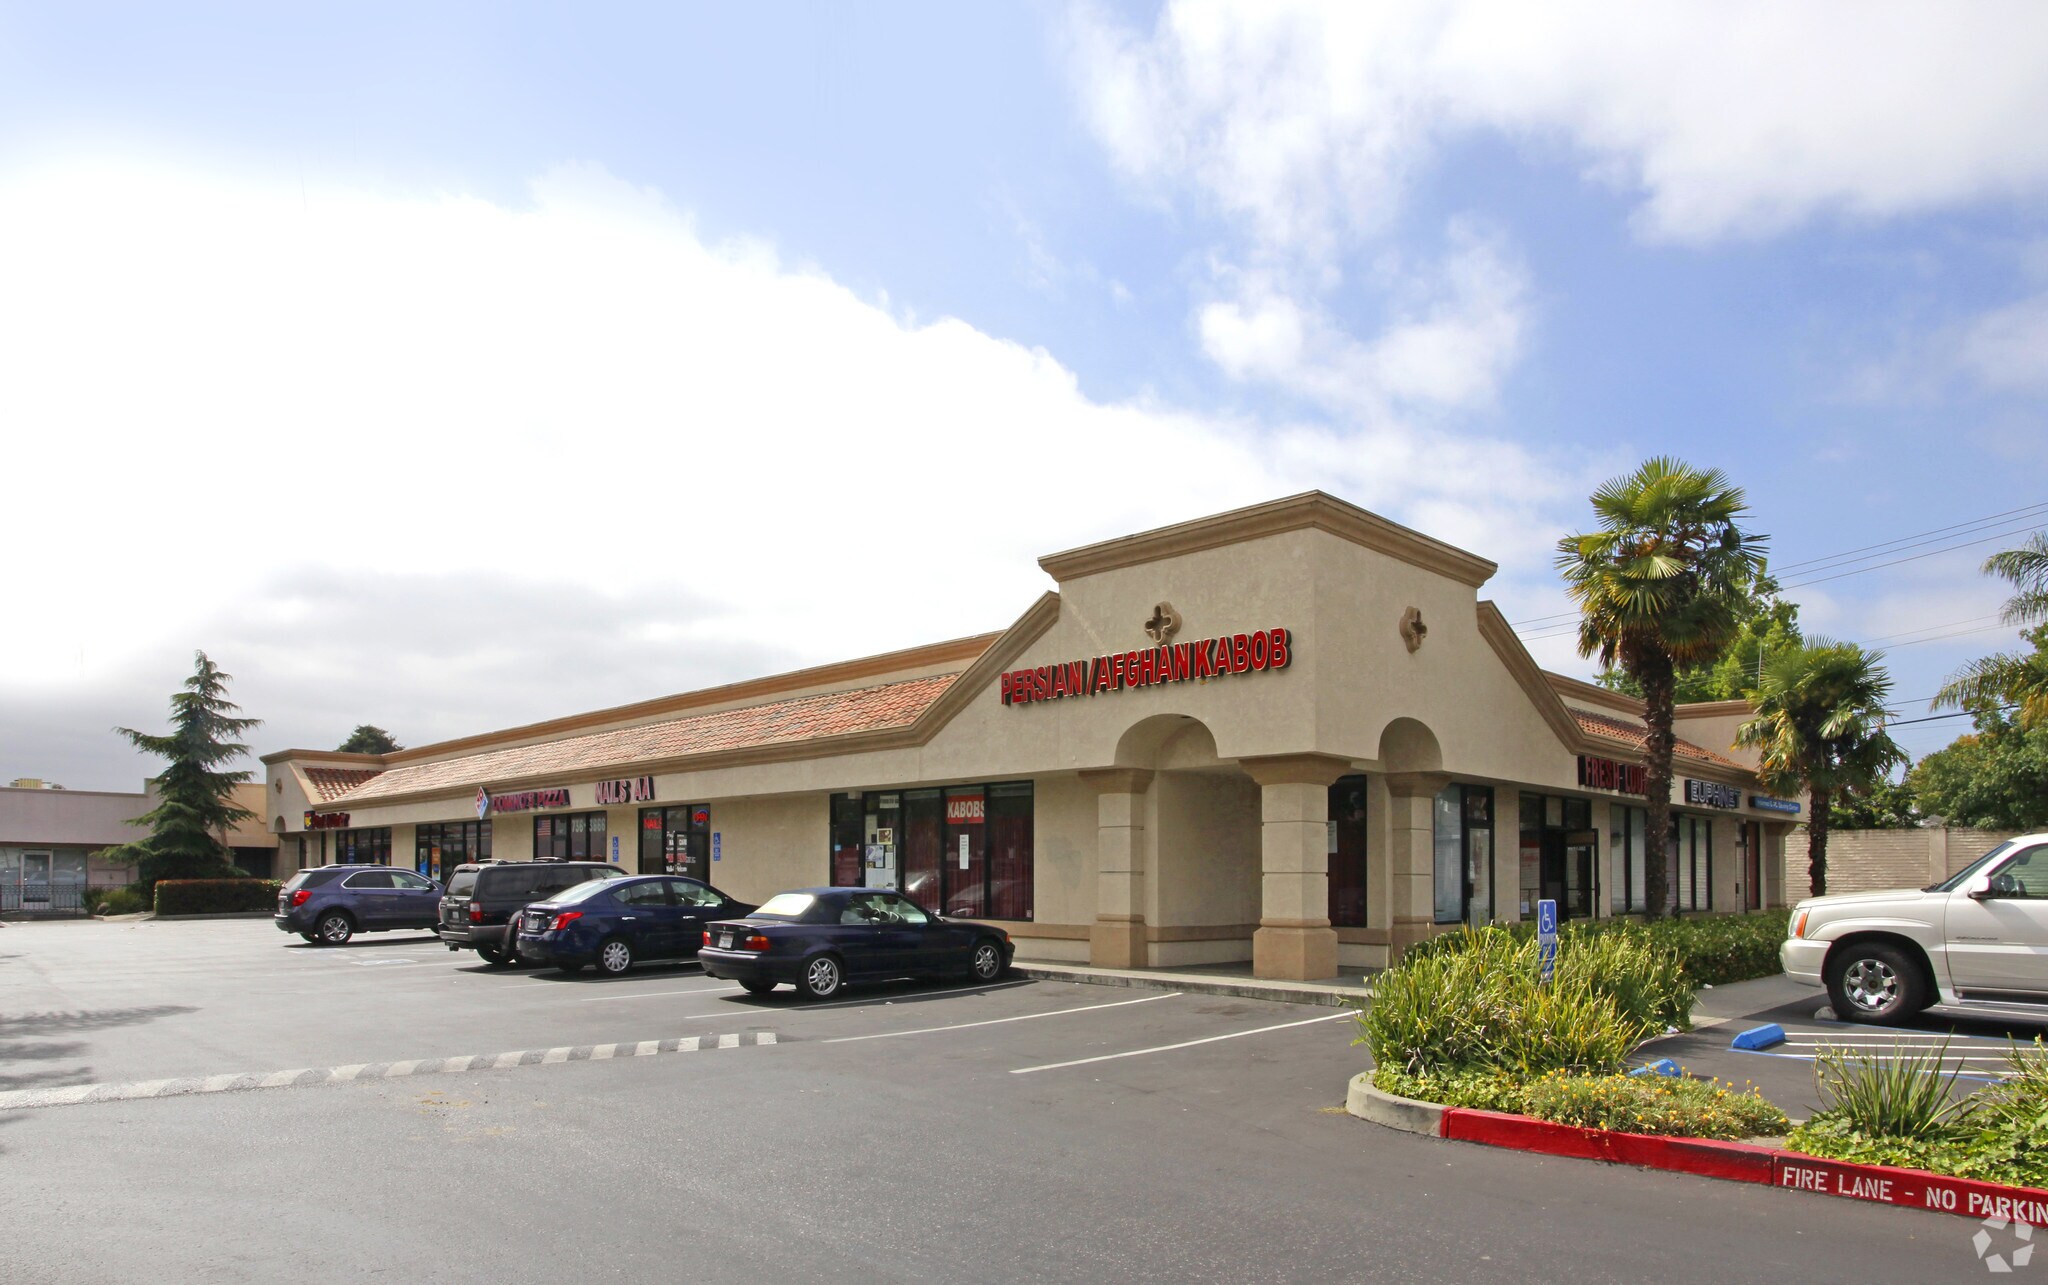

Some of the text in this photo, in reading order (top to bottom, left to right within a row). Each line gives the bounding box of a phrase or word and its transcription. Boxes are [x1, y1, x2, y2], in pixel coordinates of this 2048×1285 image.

[1195, 627, 1290, 679] KABOB
[1585, 755, 1619, 790] FRESH
[537, 788, 569, 807] PIZZA
[595, 776, 654, 804] NAILS AA
[1690, 780, 1741, 808] EUPHNET
[947, 800, 985, 818] KABOBS
[1782, 1166, 1828, 1192] FIRE
[1838, 1174, 1893, 1201] LANE
[1926, 1186, 1957, 1211] NO
